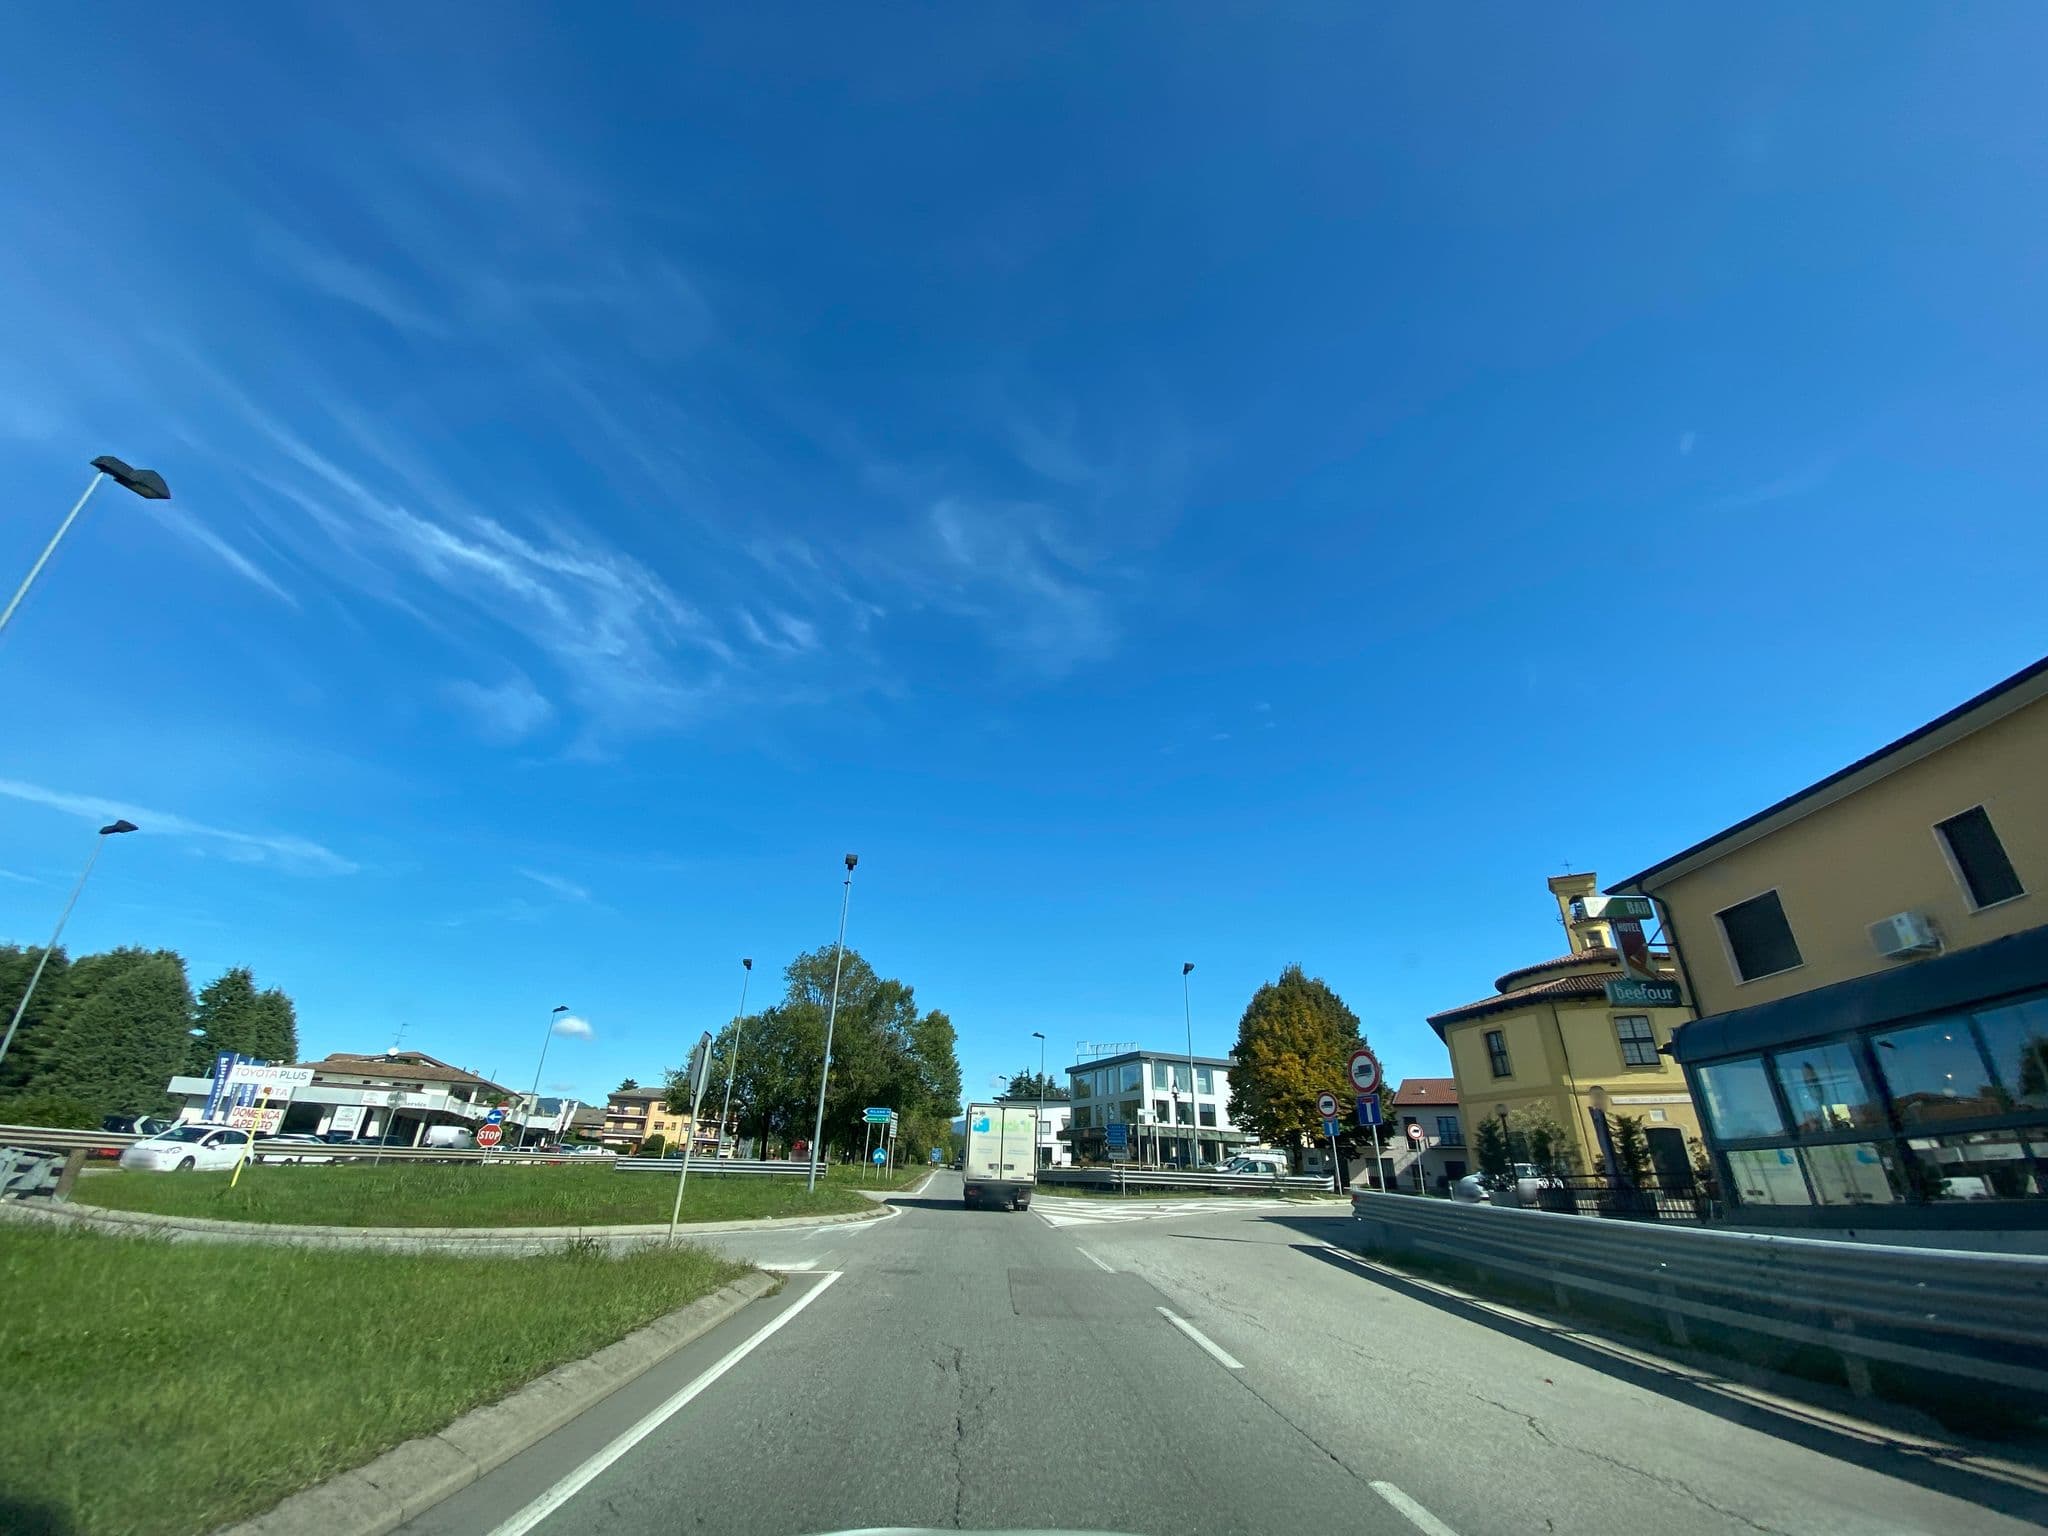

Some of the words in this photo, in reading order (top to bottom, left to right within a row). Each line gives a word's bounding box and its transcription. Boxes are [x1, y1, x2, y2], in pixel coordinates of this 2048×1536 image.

[1626, 901, 1650, 914] BAR
[1616, 922, 1641, 932] HOTEL
[1614, 983, 1674, 1000] beefour
[236, 1067, 278, 1078] TOYOTA
[279, 1071, 309, 1081] PLUS
[232, 1107, 281, 1120] DOMENICA
[479, 1130, 501, 1140] STOP
